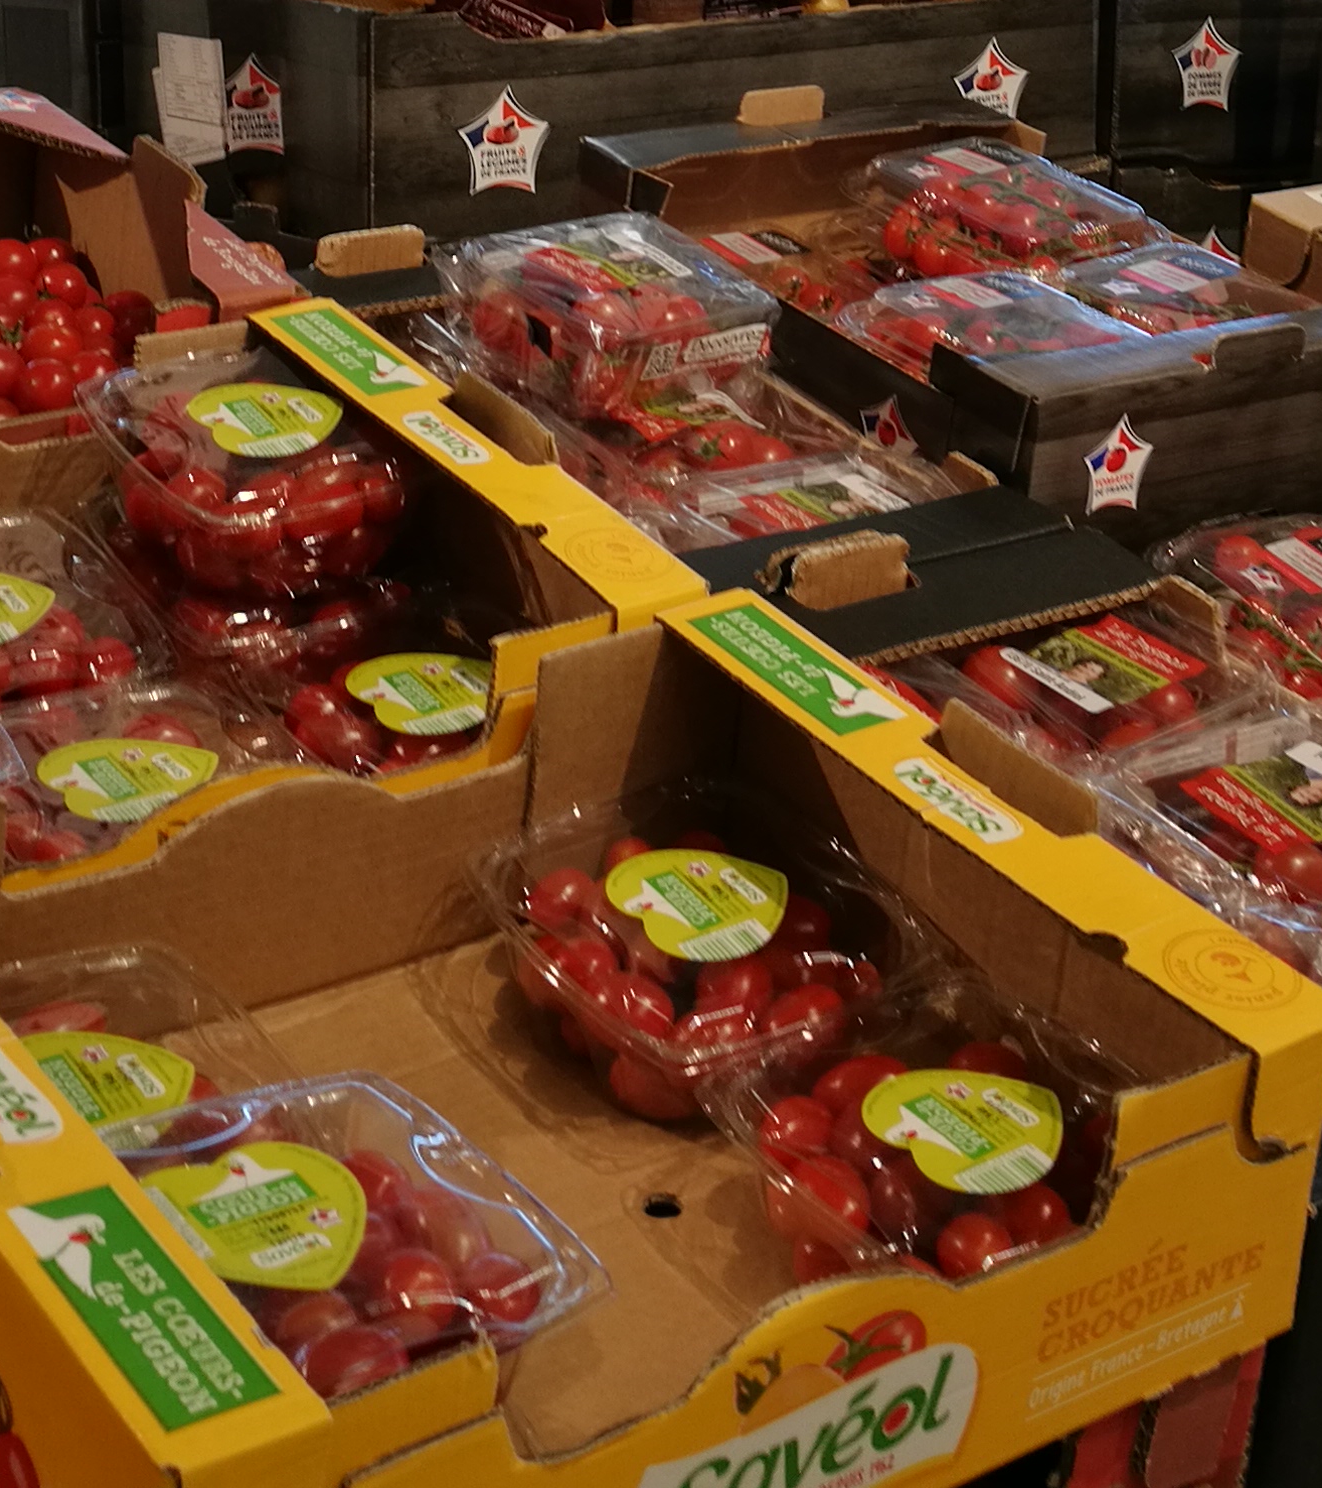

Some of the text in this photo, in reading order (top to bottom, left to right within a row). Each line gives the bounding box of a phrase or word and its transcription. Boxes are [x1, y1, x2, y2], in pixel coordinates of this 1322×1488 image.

[231, 113, 268, 123] FRUITS
[481, 147, 517, 158] FRUITS
[407, 412, 480, 459] Savéol
[896, 764, 1003, 834] Savéol
[112, 1248, 167, 1296] LES
[1043, 1238, 1187, 1328] SUCRÉE
[1037, 1241, 1265, 1363] CROQUANTE
[1029, 1370, 1086, 1409] Origine
